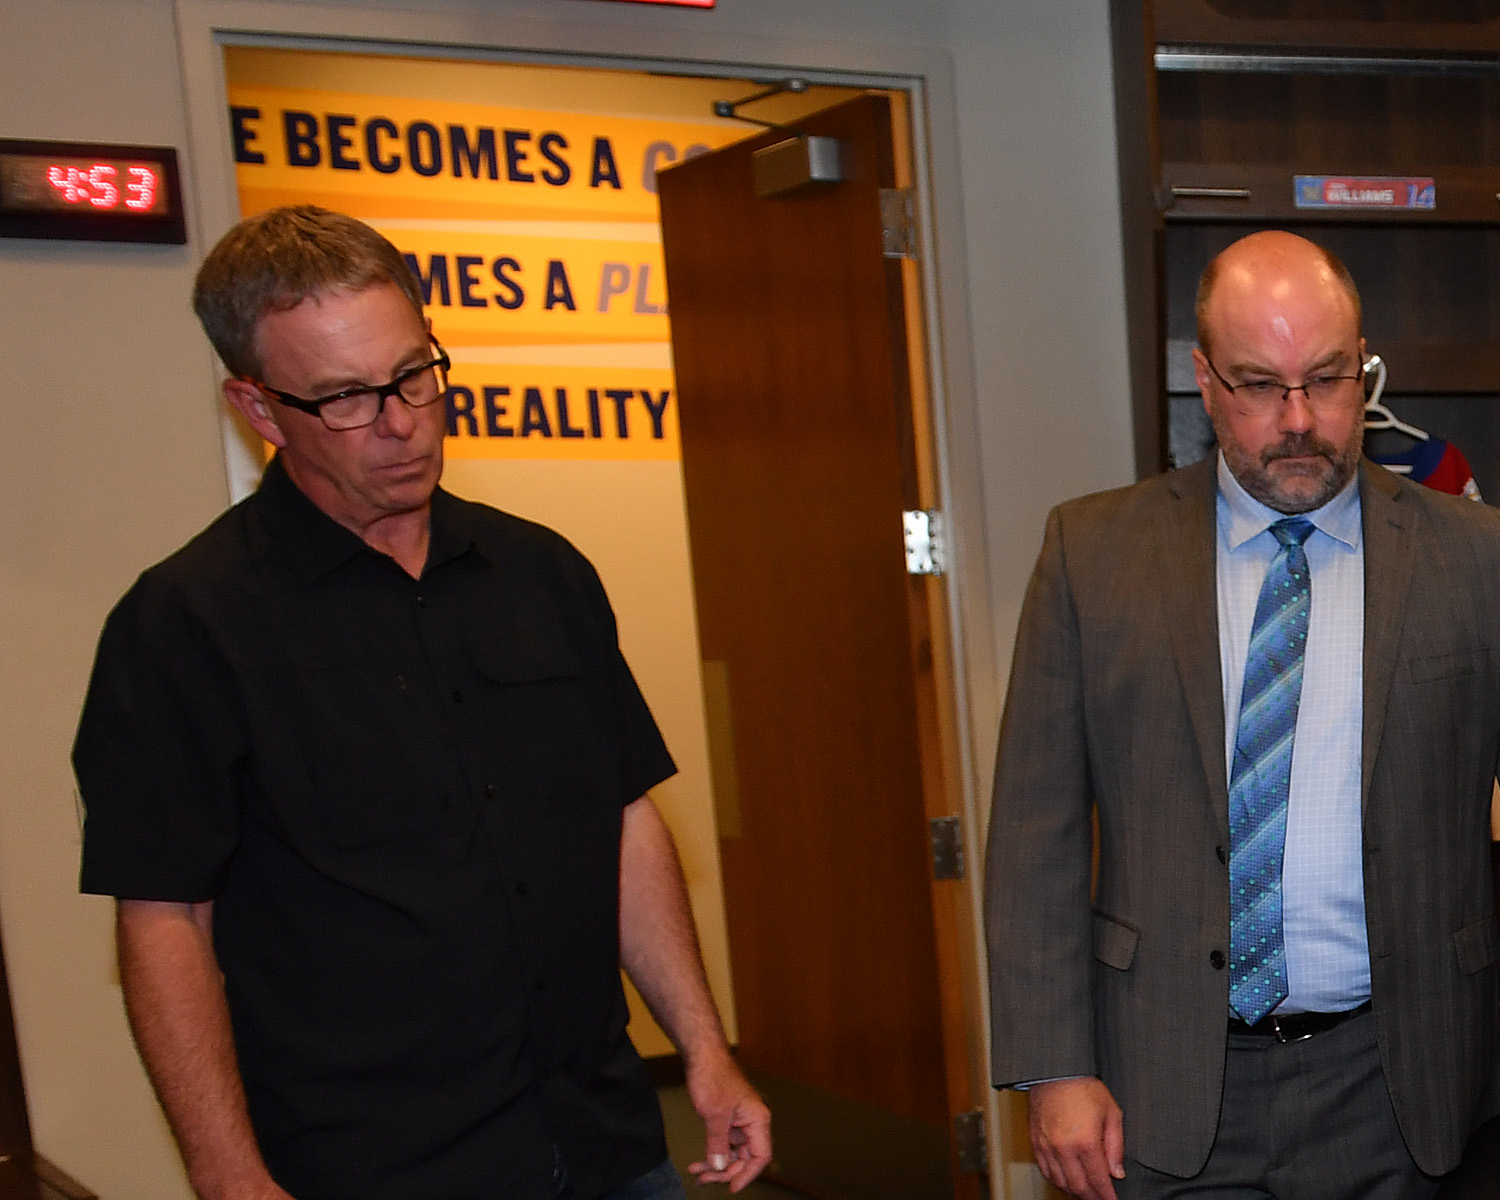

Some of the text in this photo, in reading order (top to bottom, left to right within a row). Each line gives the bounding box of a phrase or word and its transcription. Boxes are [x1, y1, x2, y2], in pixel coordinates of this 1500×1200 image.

[283, 110, 571, 187] BECOMES
[590, 136, 622, 191] A
[47, 164, 157, 212] 4:53
[1329, 189, 1394, 202] WILLIAMS
[543, 260, 577, 311] A
[446, 385, 670, 439] REALITY
